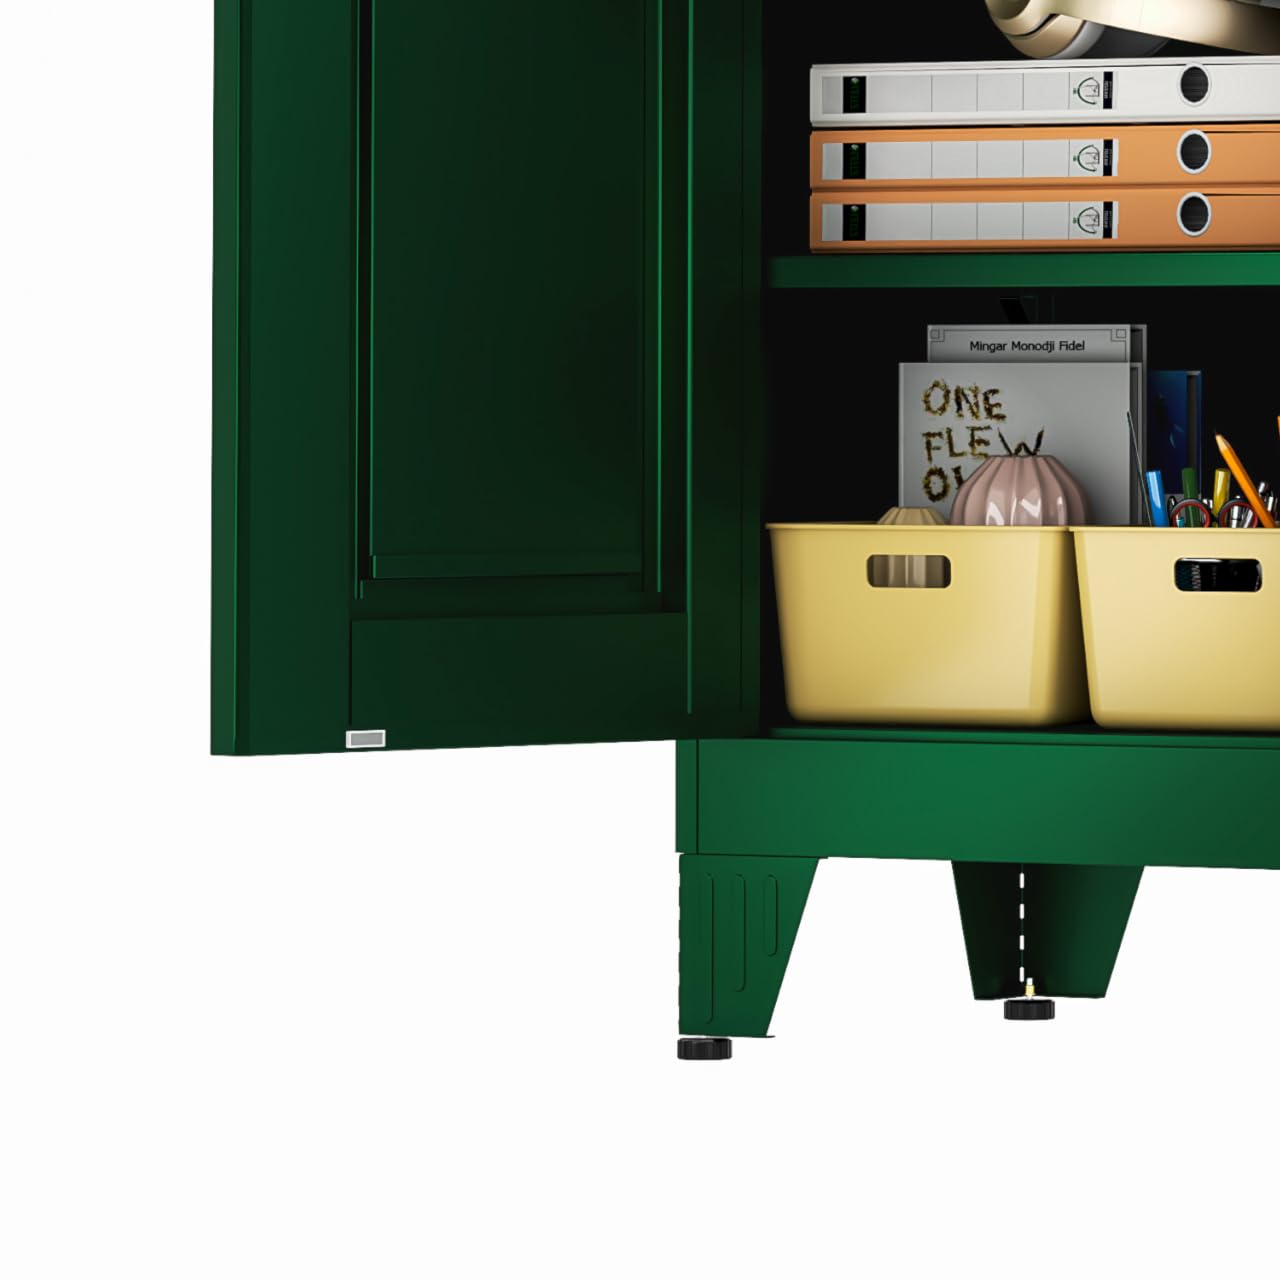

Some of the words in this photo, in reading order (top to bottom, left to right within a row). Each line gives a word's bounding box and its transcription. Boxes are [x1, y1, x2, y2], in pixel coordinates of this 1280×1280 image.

[970, 341, 1007, 353] Mingar
[1011, 340, 1055, 353] Monodji
[1059, 340, 1085, 351] Fidel
[922, 379, 1006, 421] ONE
[922, 425, 1044, 462] FLEW
